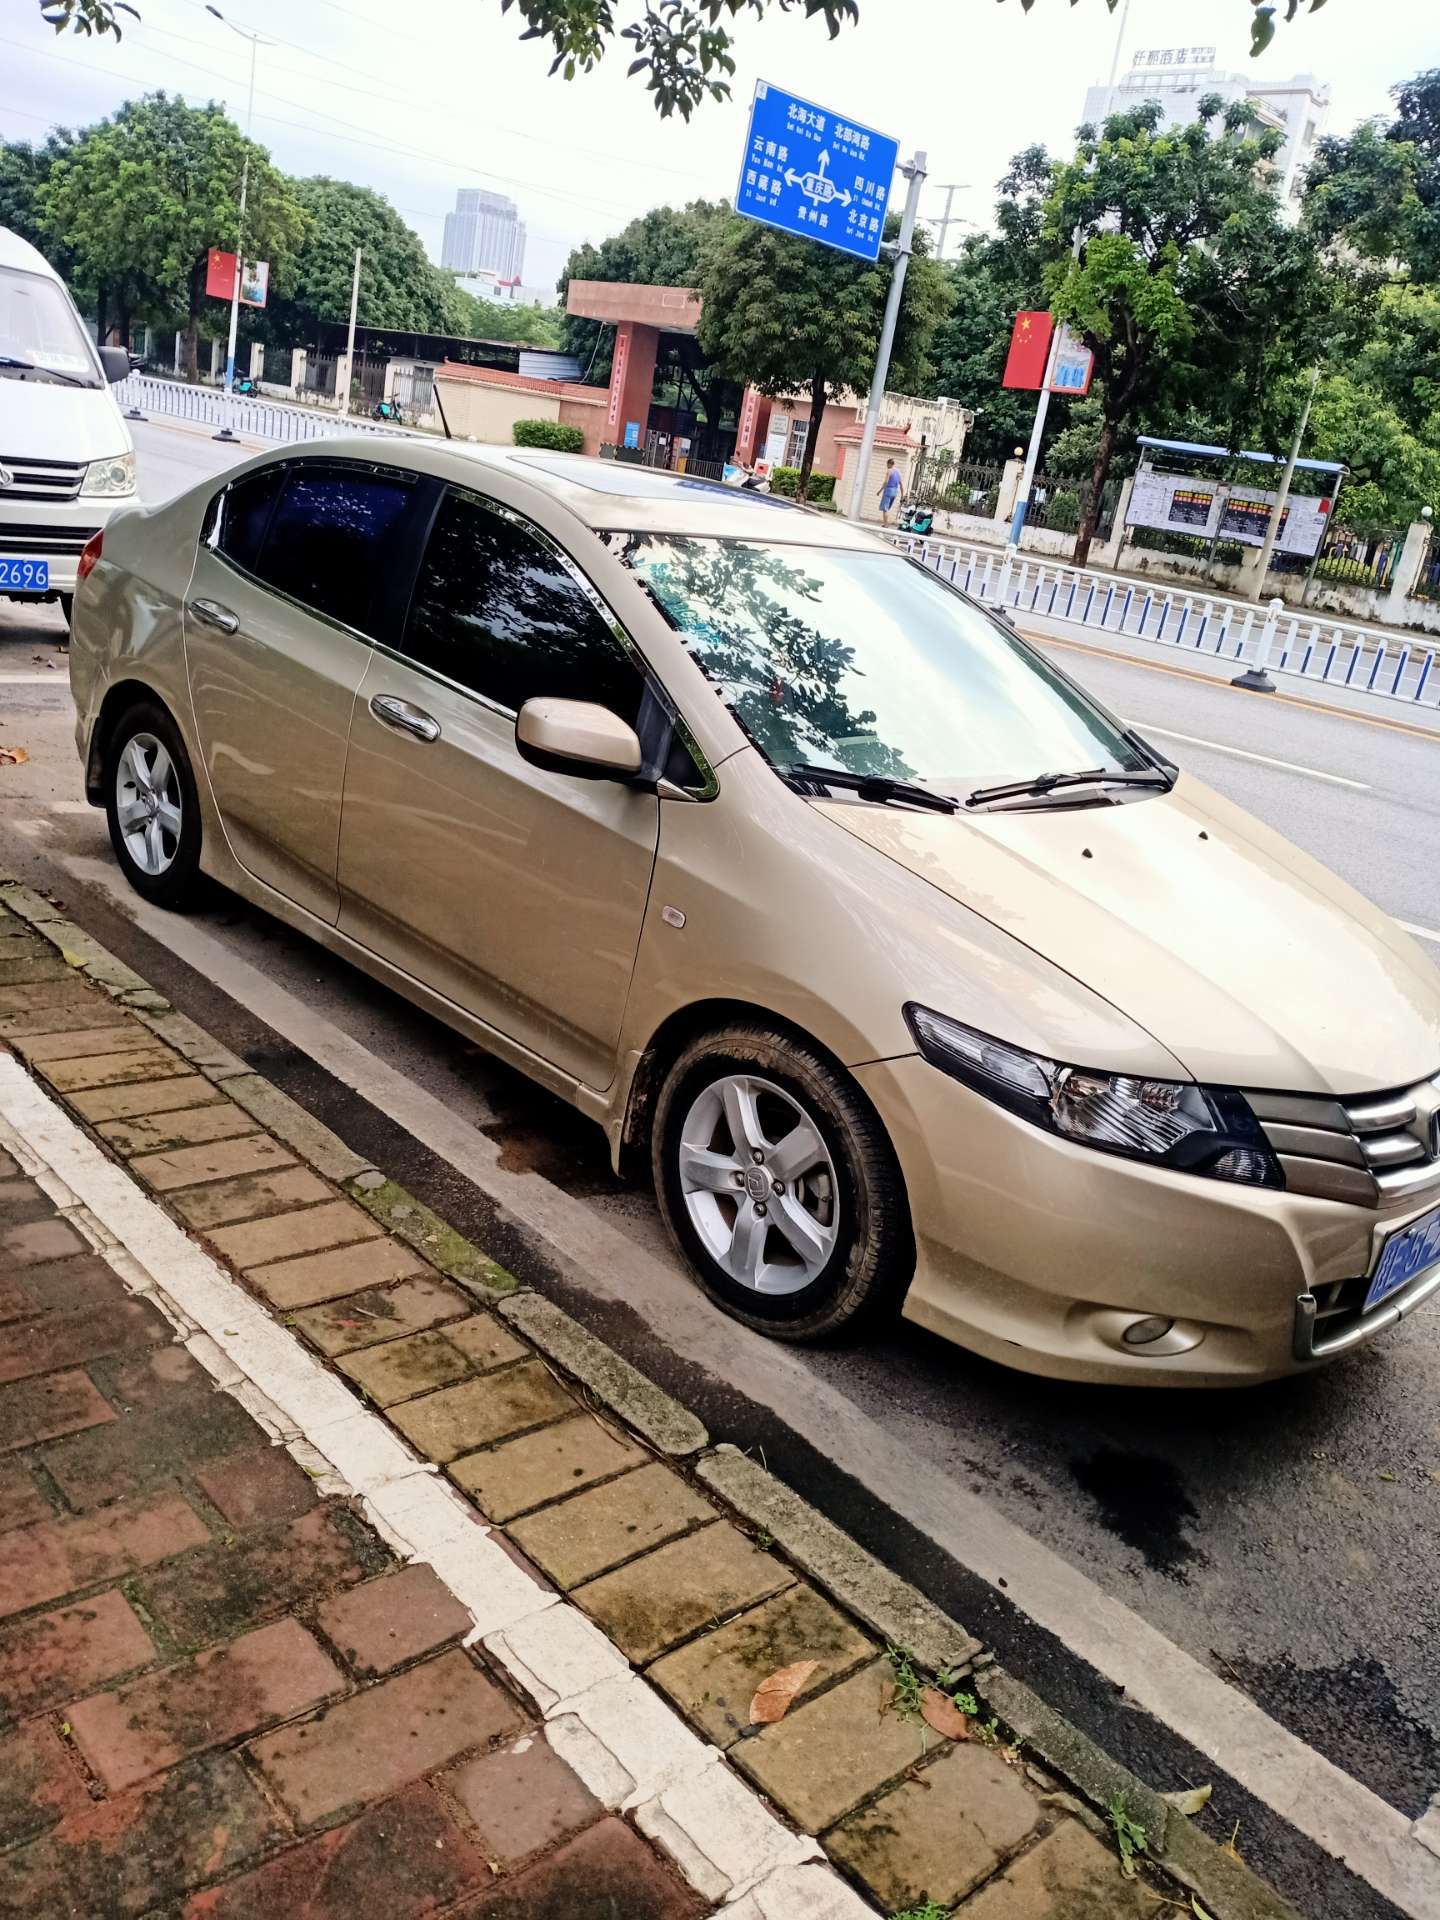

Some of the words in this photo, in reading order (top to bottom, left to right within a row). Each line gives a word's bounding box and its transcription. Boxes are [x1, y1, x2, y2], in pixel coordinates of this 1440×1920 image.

[787, 102, 826, 132] 北海大道
[753, 135, 788, 162] 云南路
[746, 168, 782, 197] 西藏路
[805, 177, 833, 199] 重庆路
[854, 175, 886, 201] 四川路
[848, 208, 879, 233] 北京路
[0, 563, 46, 585] 2696
